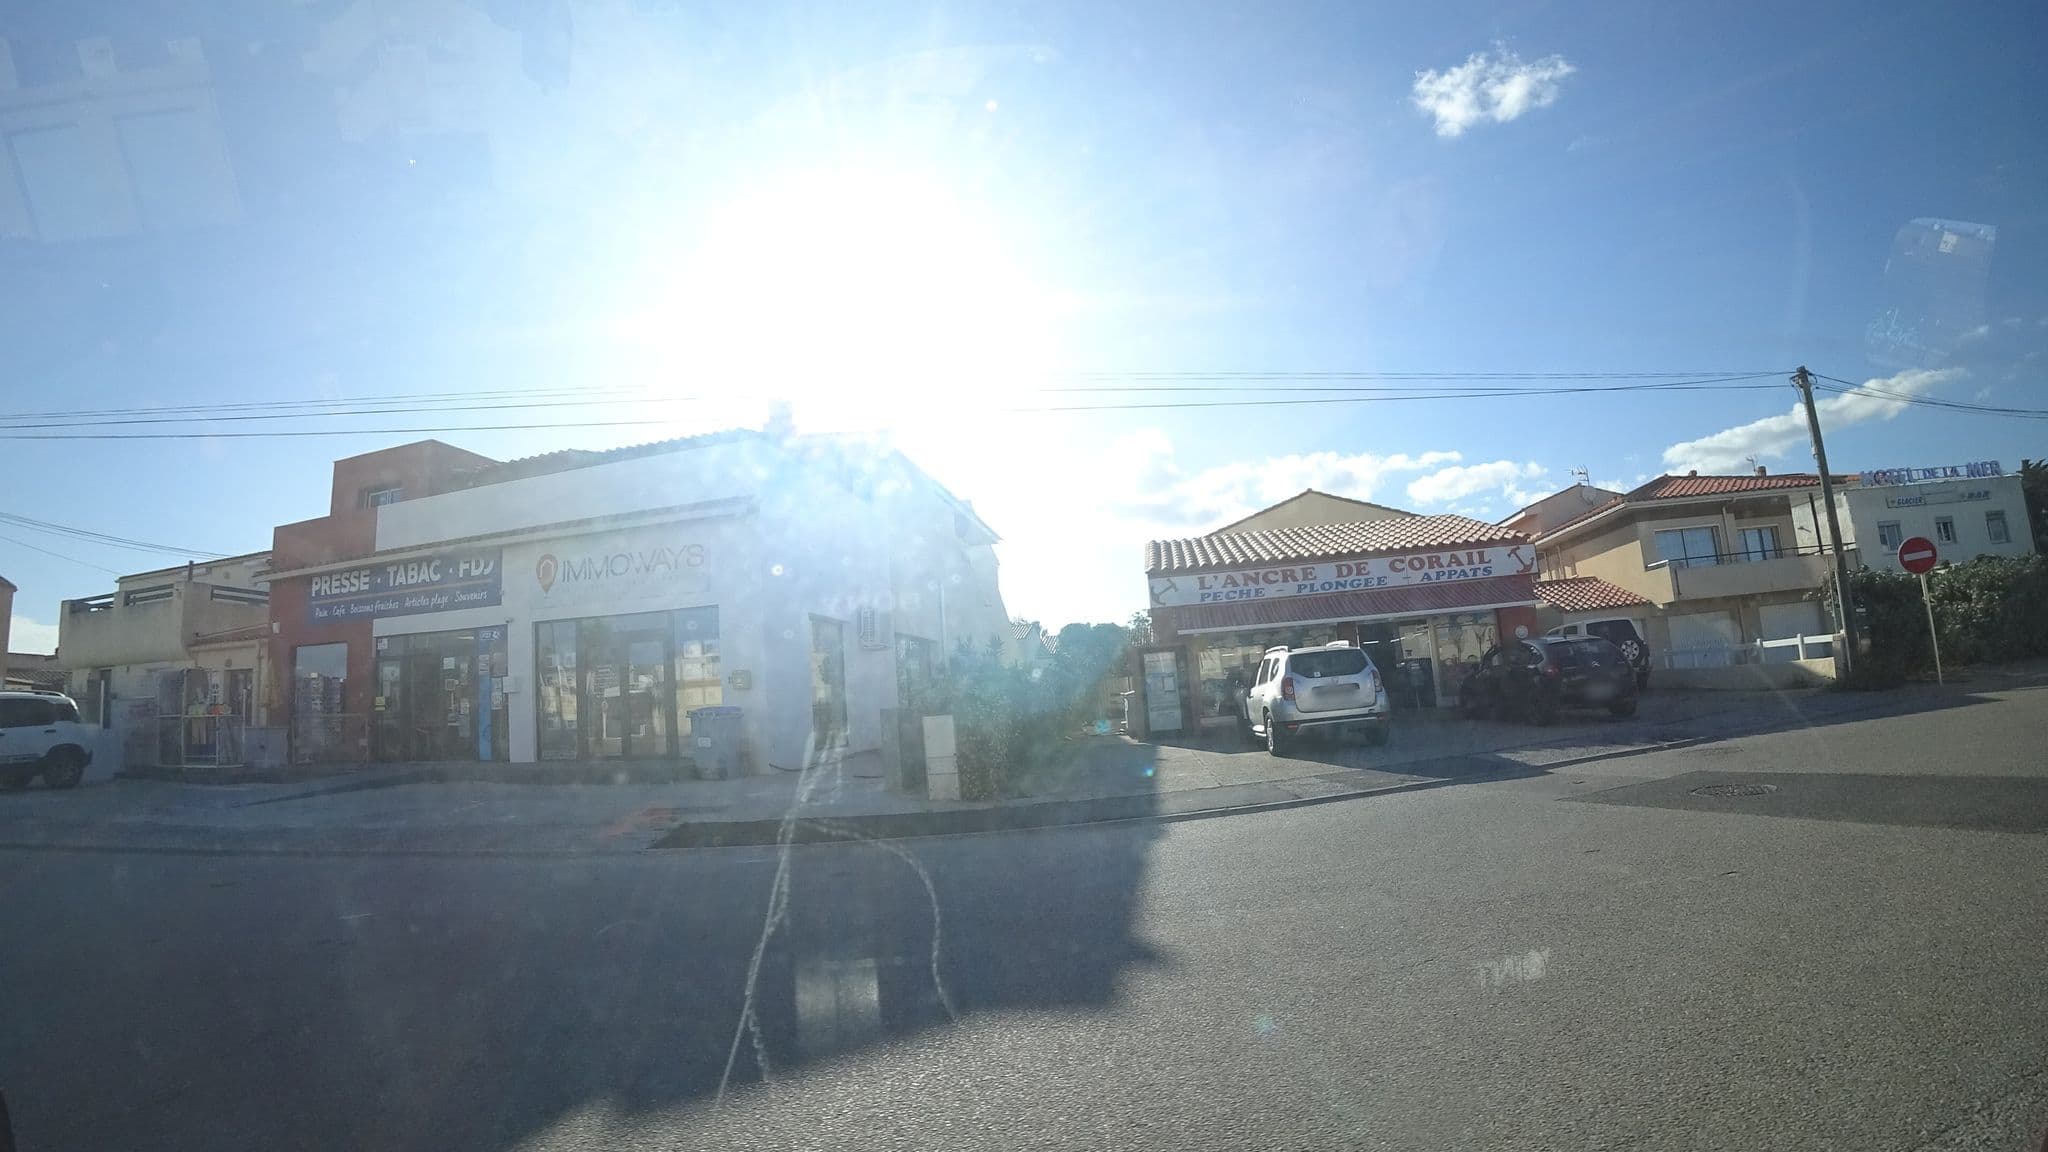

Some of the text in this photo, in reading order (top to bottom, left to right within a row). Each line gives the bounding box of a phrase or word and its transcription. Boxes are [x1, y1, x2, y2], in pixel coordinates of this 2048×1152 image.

[1966, 460, 2002, 478] MER
[311, 558, 495, 597] PRESSE TABAC FDJ
[562, 543, 704, 583] IMMOWAYS
[1198, 550, 1492, 590] L'ANCRE DE CORAIL
[430, 592, 449, 609] plage
[454, 590, 488, 603] Souvenirs
[1200, 566, 1493, 602] PECHE PLONGEE APPATS
